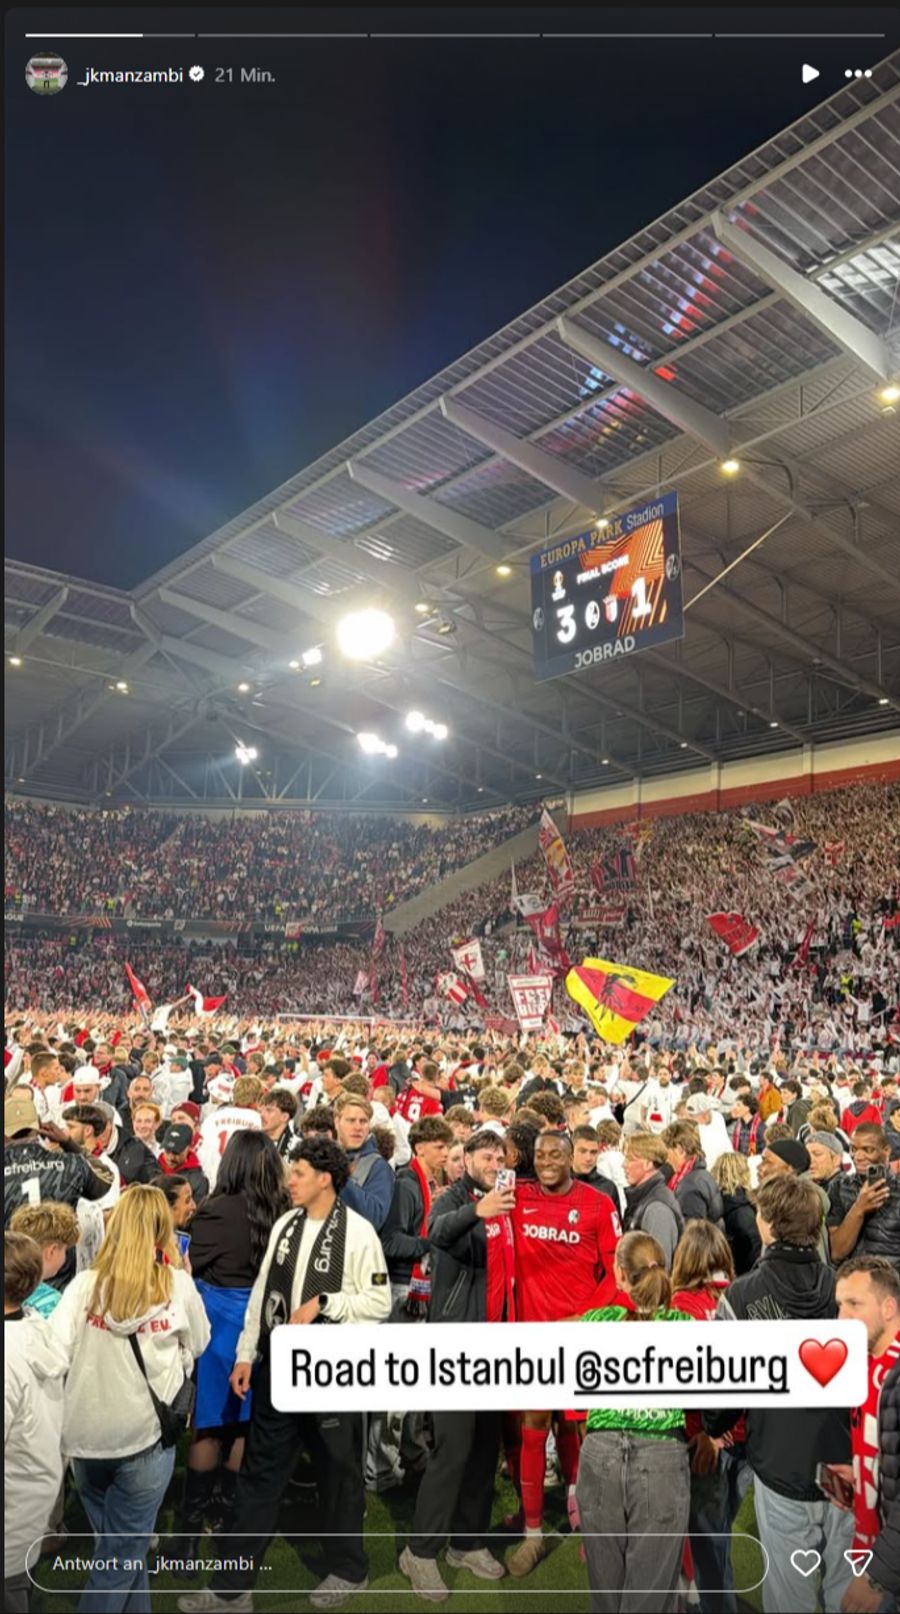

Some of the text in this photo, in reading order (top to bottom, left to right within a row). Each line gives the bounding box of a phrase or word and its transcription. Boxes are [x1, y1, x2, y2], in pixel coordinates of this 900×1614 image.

[540, 503, 665, 569] EUROPA PARK Stadion
[556, 577, 652, 644] 3 1
[574, 635, 636, 669] JOBRAD
[21, 1177, 41, 1207] 1
[522, 1223, 580, 1244] JOBRAD
